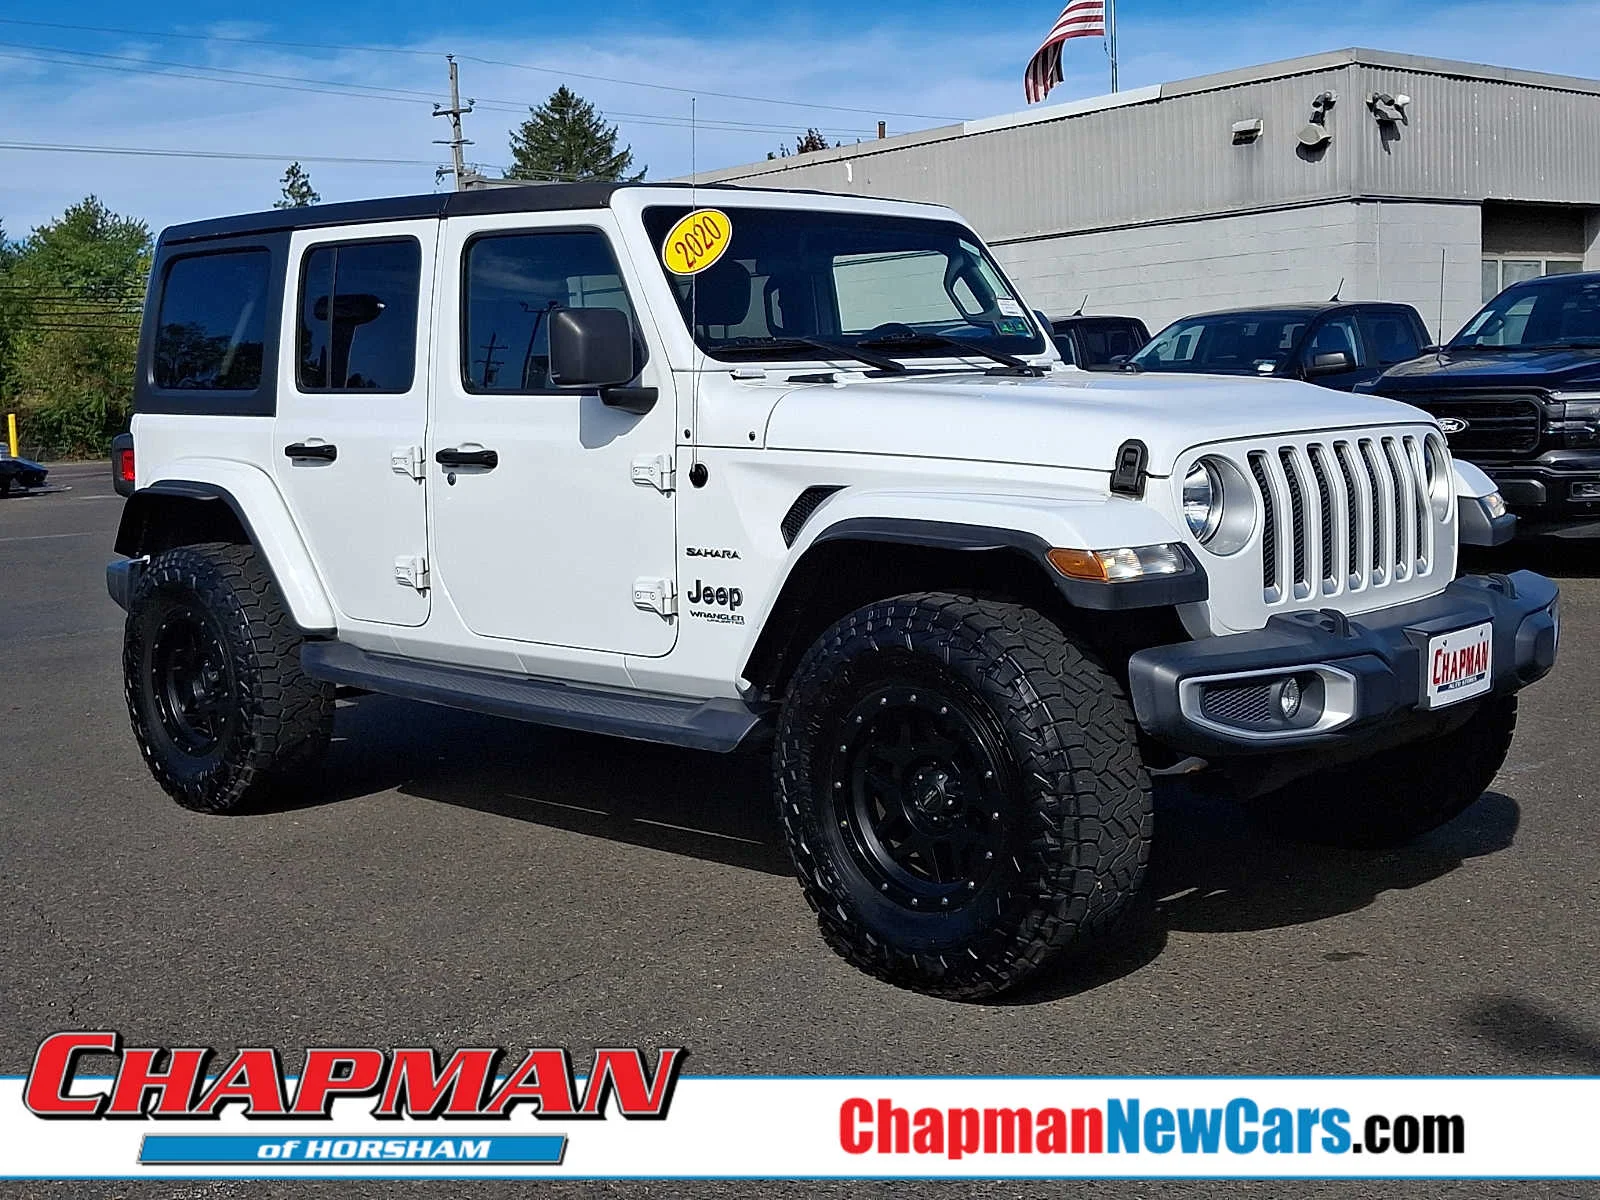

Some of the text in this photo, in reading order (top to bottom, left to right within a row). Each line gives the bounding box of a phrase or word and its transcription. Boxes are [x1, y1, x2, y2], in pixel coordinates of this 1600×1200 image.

[675, 216, 721, 268] 2020
[686, 547, 741, 560] SAHARA
[687, 579, 744, 611] Jeep
[689, 610, 745, 623] WRANGLER
[1433, 639, 1489, 685] CHAPMAN
